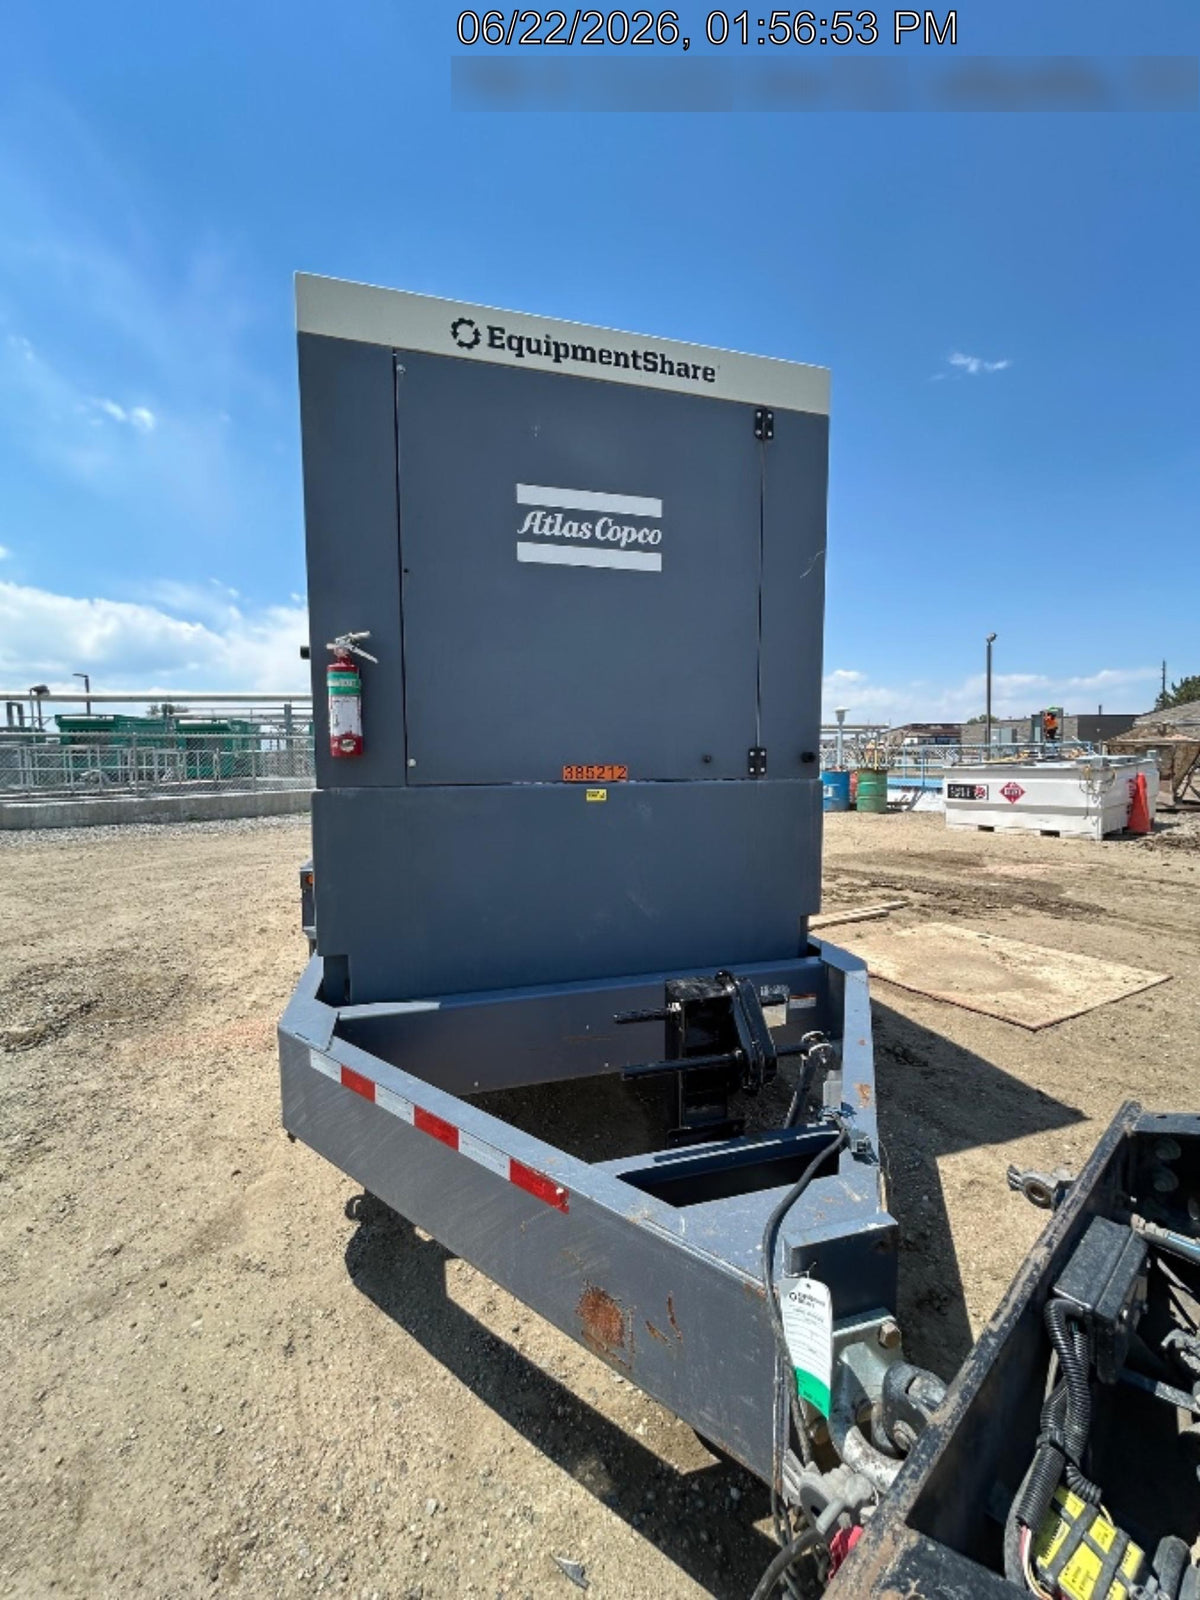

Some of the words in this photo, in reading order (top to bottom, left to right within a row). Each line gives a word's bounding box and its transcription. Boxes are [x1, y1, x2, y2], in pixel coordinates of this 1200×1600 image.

[487, 325, 716, 383] EquipmentShare
[517, 510, 592, 539] Atlas
[595, 517, 662, 547] Copco
[564, 765, 627, 779] 385212
